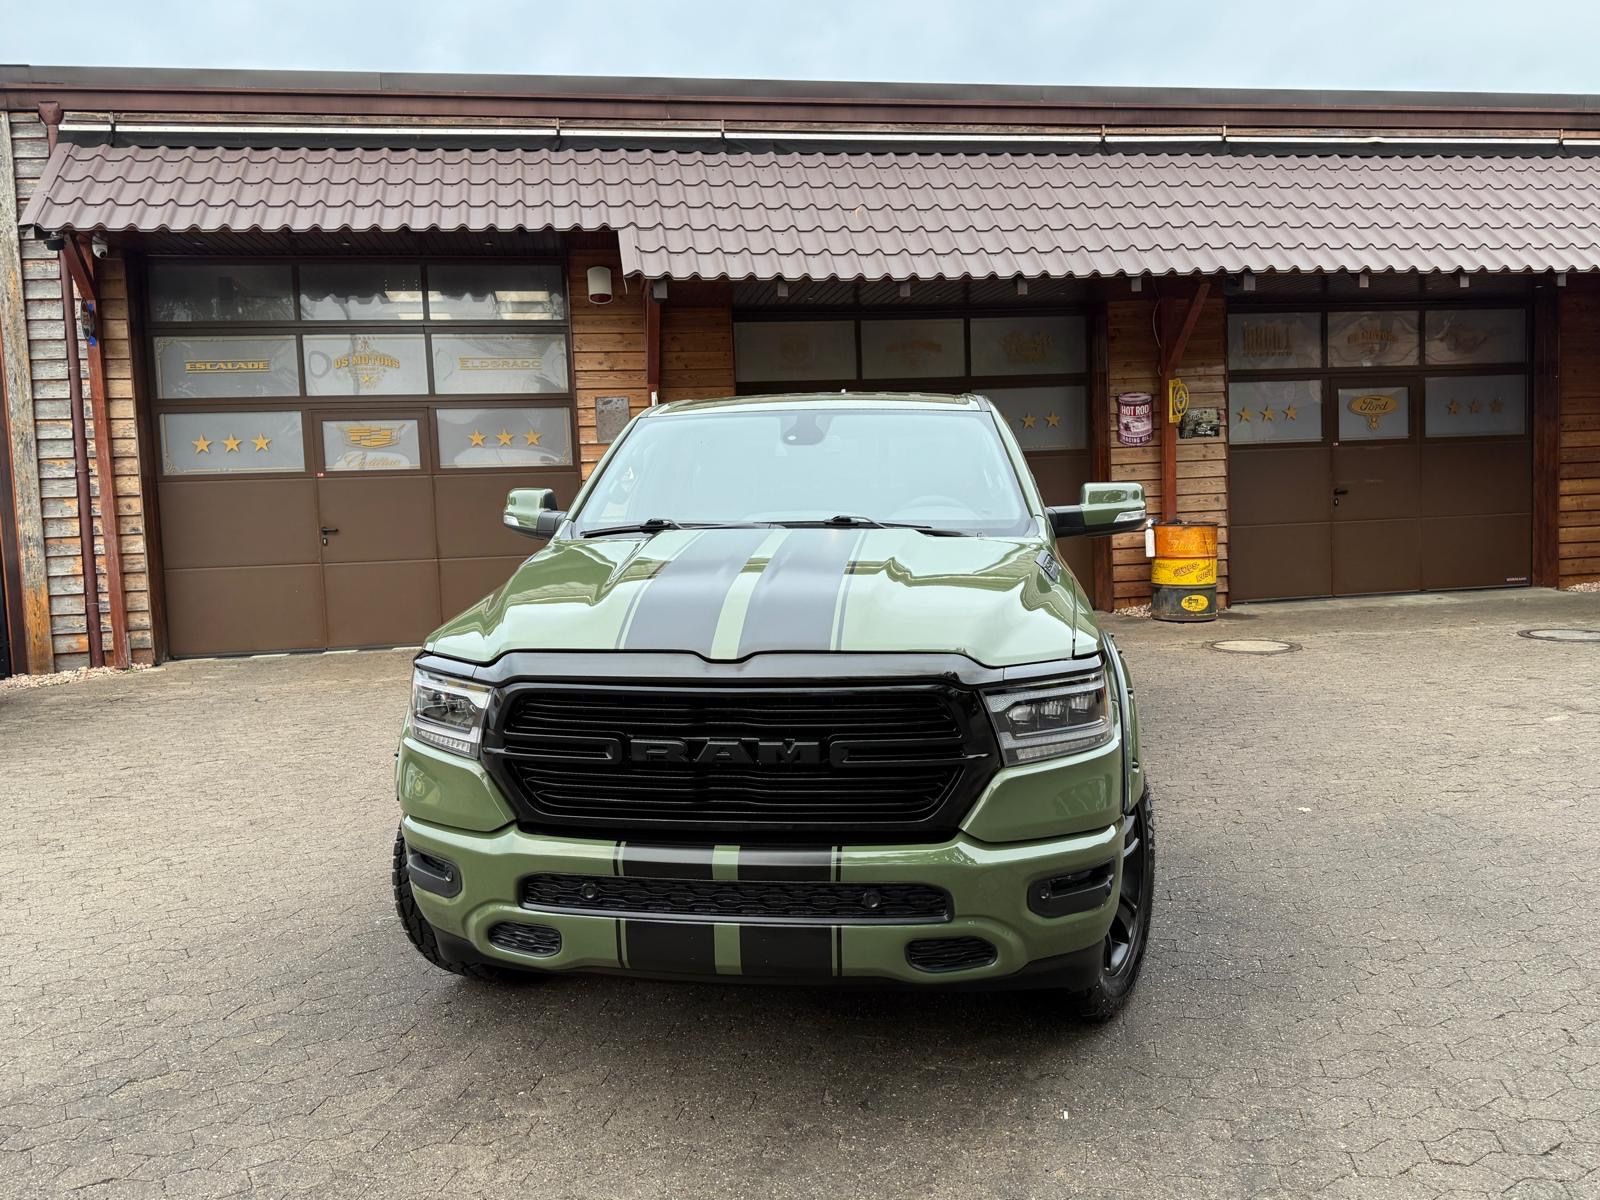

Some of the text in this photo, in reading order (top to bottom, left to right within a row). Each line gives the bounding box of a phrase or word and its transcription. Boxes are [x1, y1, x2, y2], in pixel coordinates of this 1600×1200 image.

[185, 362, 268, 370] ESCALADE
[335, 355, 400, 369] US MOTORS
[460, 360, 542, 369] ELDORADO
[1121, 404, 1149, 416] HOT ROD
[1360, 397, 1389, 411] Ford
[630, 738, 821, 764] RAM
